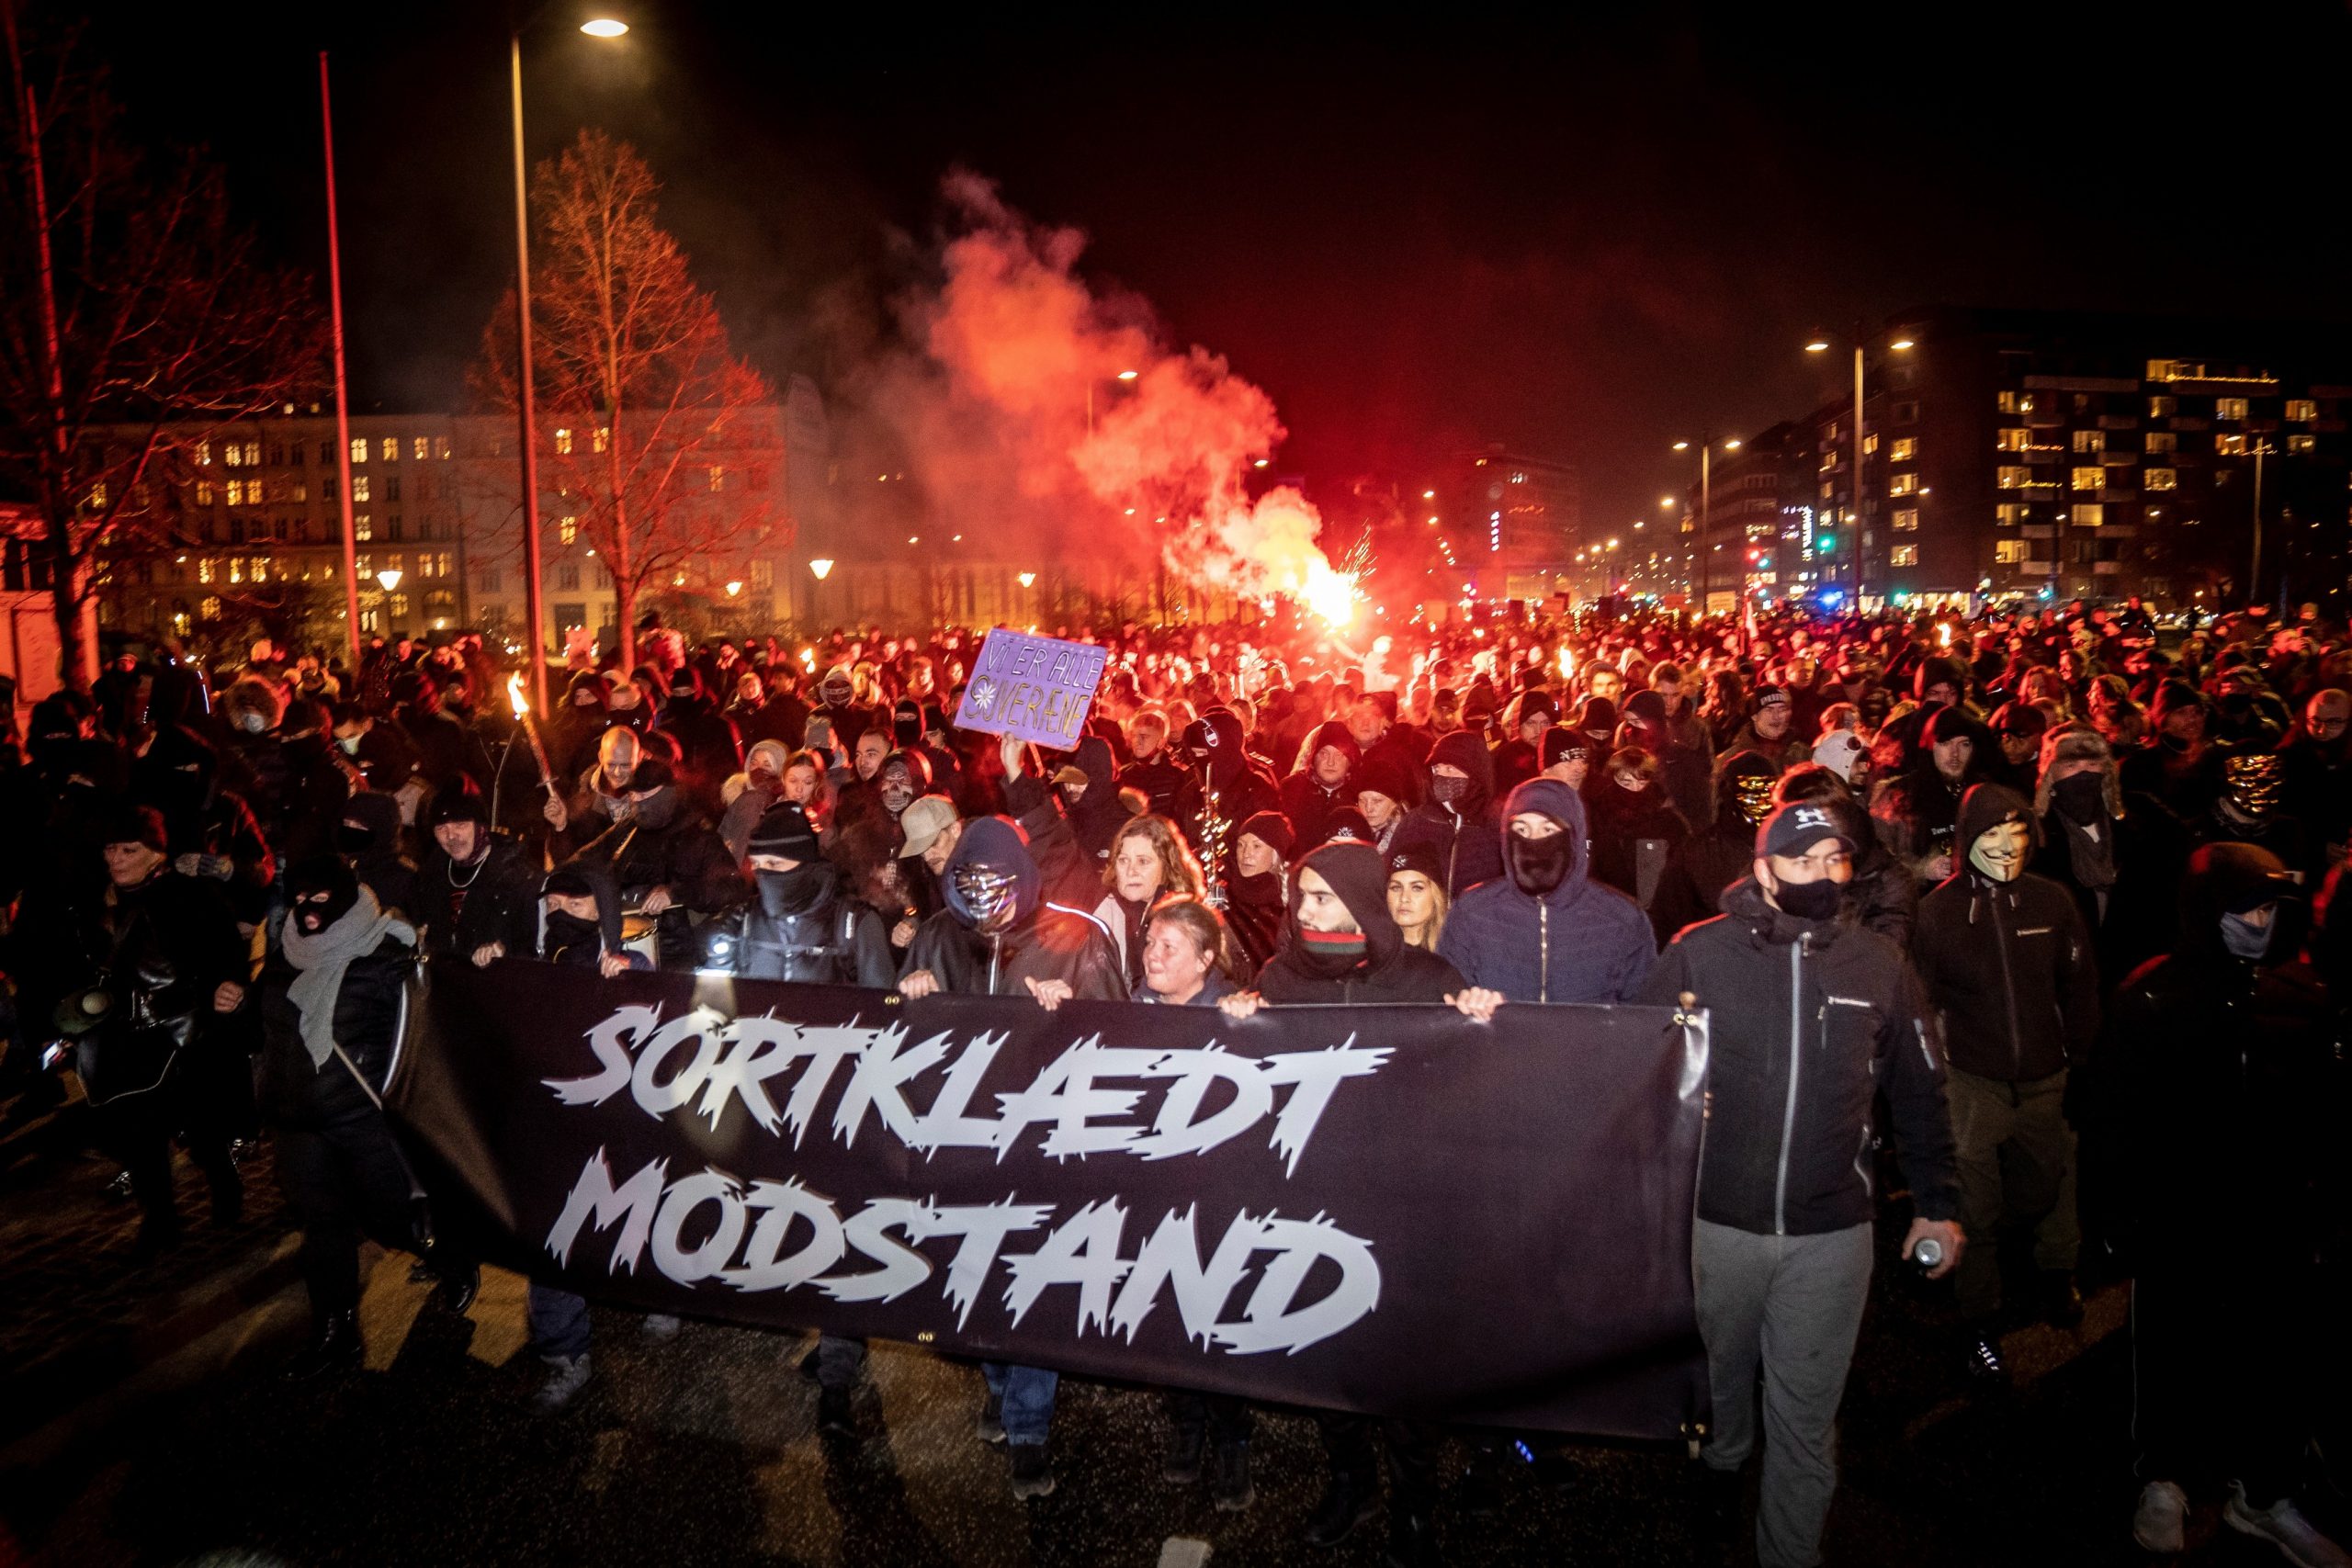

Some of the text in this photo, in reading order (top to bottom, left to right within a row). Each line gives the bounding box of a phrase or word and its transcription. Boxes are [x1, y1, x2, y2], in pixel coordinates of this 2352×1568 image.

[1012, 646, 1048, 679] ER
[1047, 650, 1103, 690] ALLE
[540, 999, 1397, 1180] SORTKLÆDT
[545, 1145, 1382, 1356] MODSTAND
